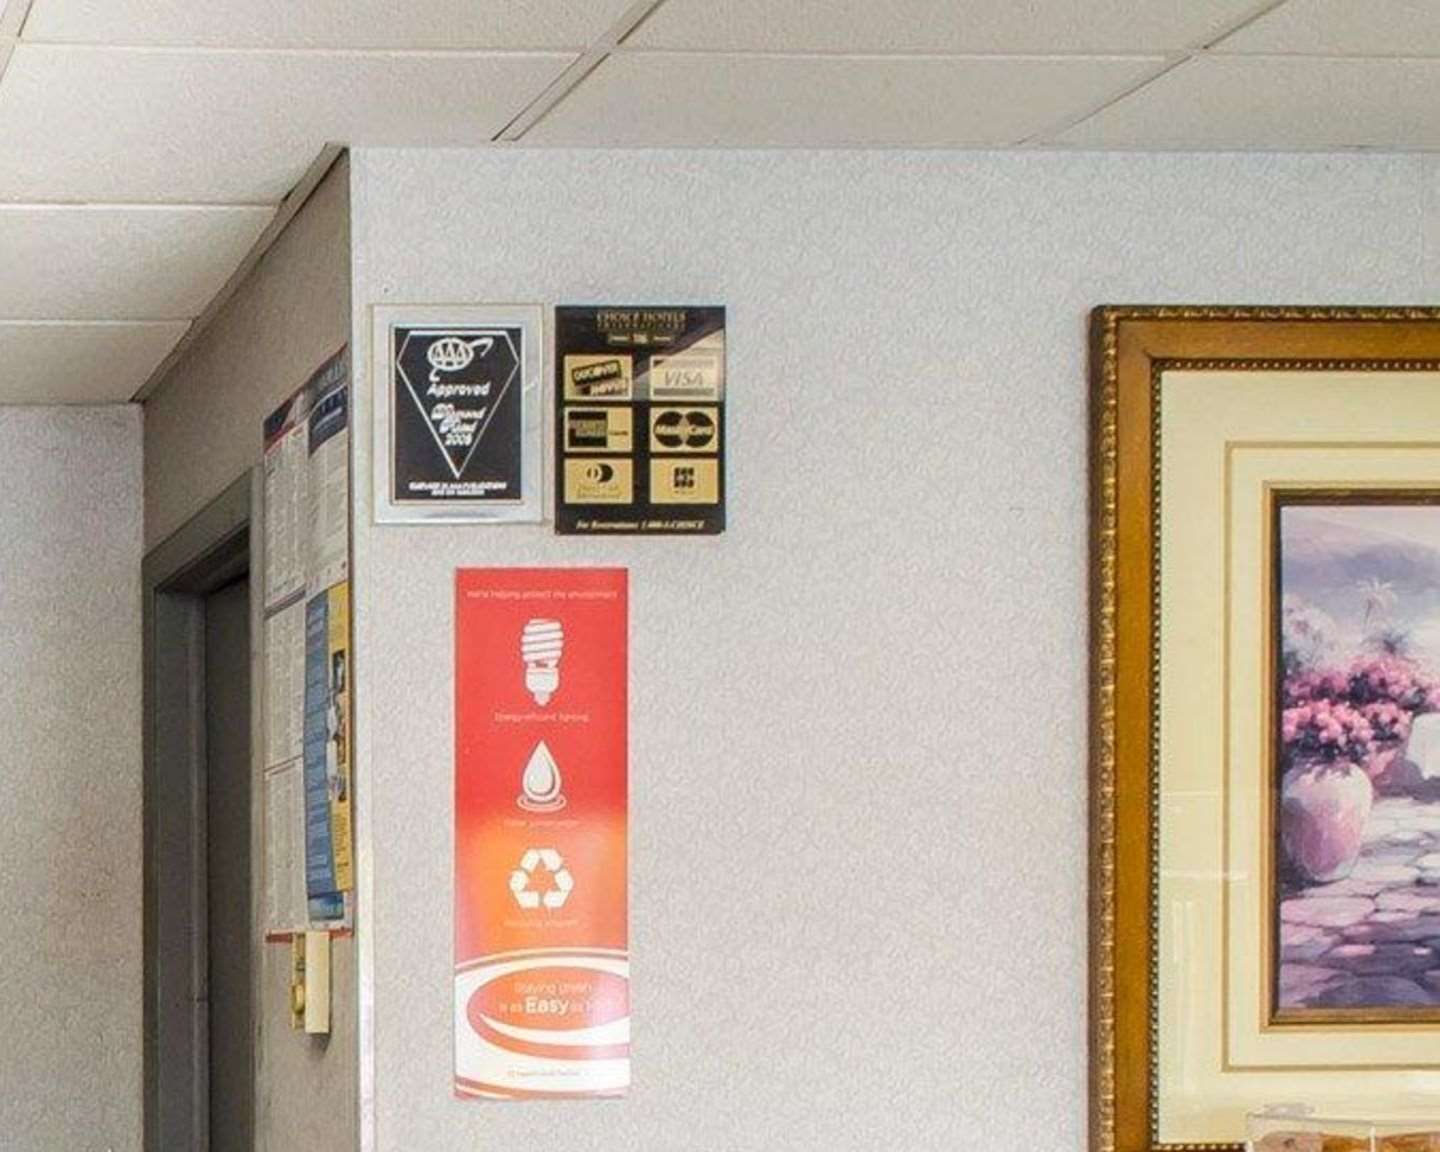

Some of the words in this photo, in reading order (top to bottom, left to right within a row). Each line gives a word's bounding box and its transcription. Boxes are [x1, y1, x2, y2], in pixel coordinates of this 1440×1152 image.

[664, 370, 704, 387] VISA
[427, 381, 492, 399] Approved
[525, 995, 569, 1016] Easy
